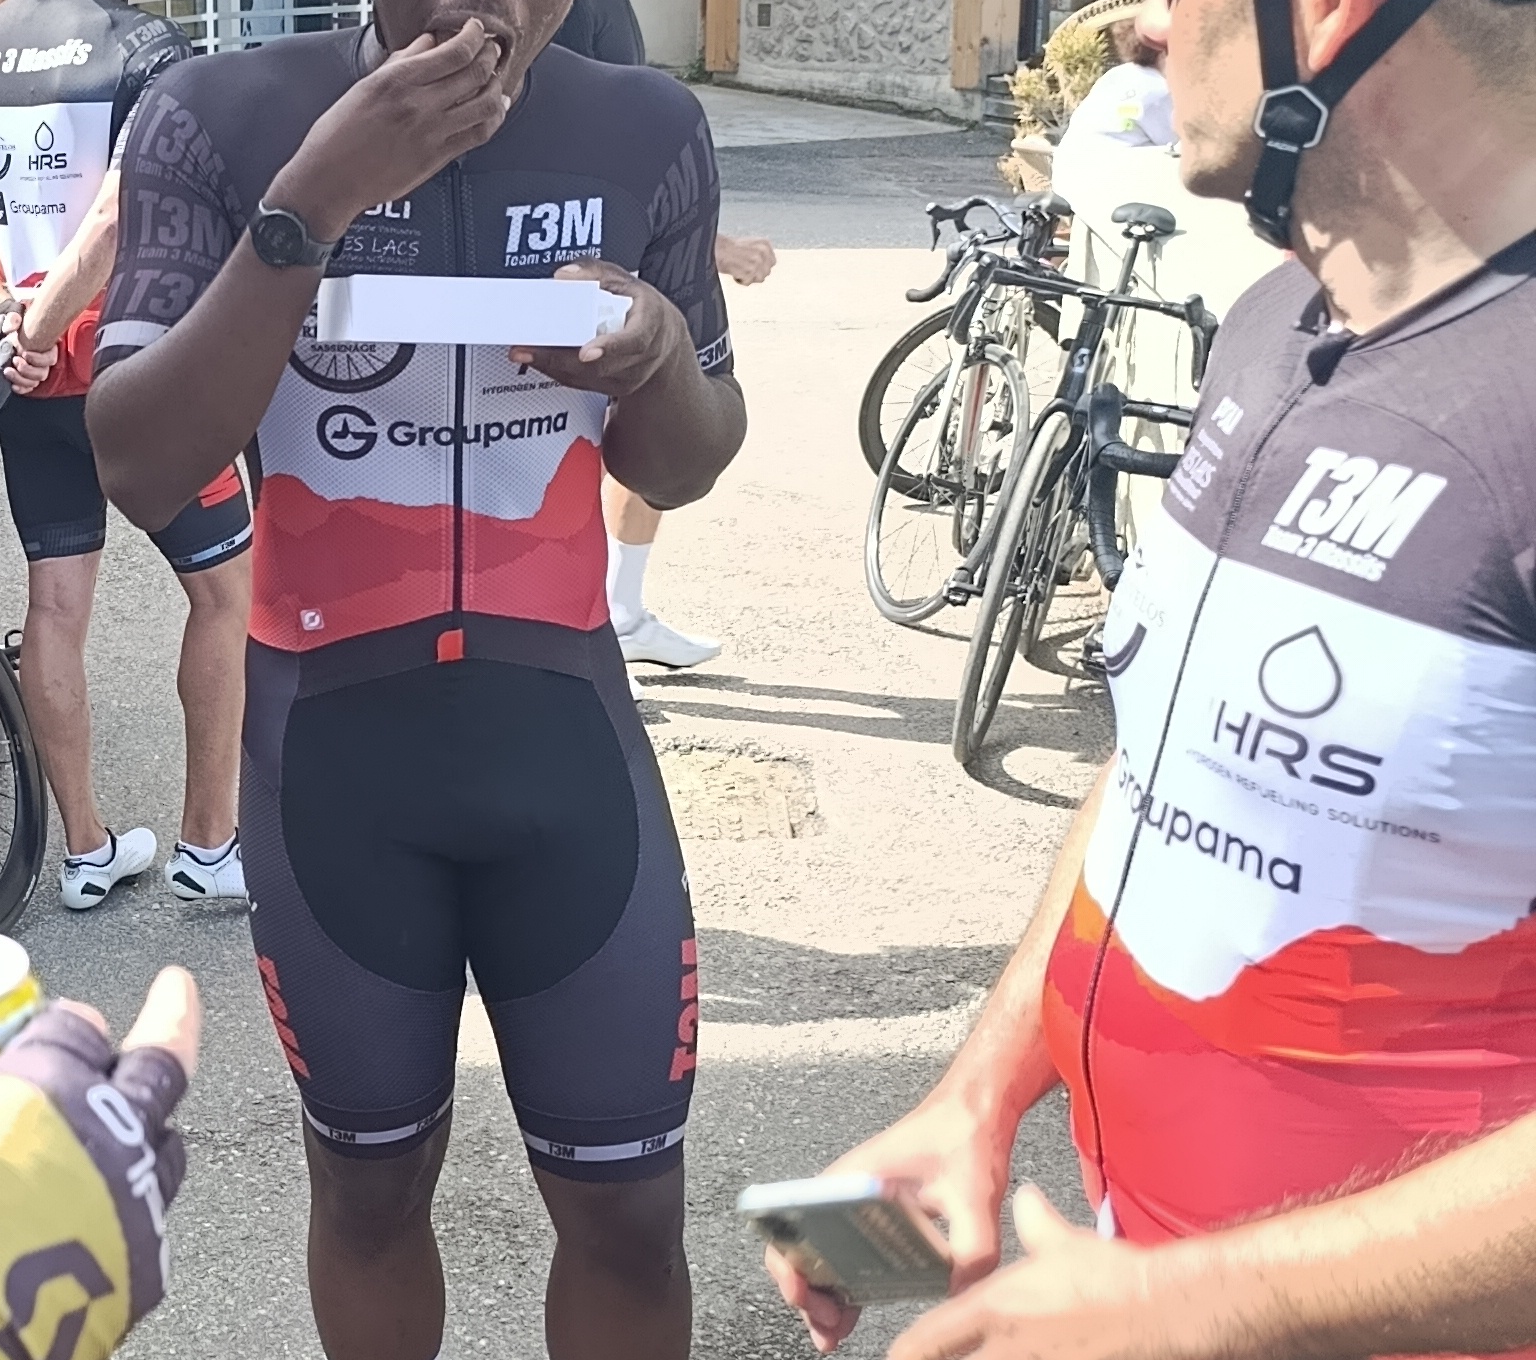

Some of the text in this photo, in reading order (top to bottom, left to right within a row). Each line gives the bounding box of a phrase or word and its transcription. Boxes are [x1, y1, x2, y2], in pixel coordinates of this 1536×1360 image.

[126, 19, 168, 48] T3M
[1, 48, 17, 73] 3
[28, 153, 68, 171] HRS
[10, 200, 67, 217] Groupama
[505, 197, 603, 254] T3M
[371, 237, 420, 257] LACS
[505, 253, 539, 267] Team
[542, 251, 552, 264] 3
[311, 344, 377, 353] SASSENAGE
[482, 380, 536, 396] HYDROGEN
[387, 411, 569, 448] Groupama
[1274, 446, 1449, 559] T3M
[1213, 699, 1384, 797] HRS
[1118, 747, 1303, 895] Groupama
[1326, 807, 1443, 844] SOLUTIONS
[327, 1126, 357, 1143] T3M
[640, 1134, 668, 1155] T3M
[548, 1142, 576, 1160] T3M
